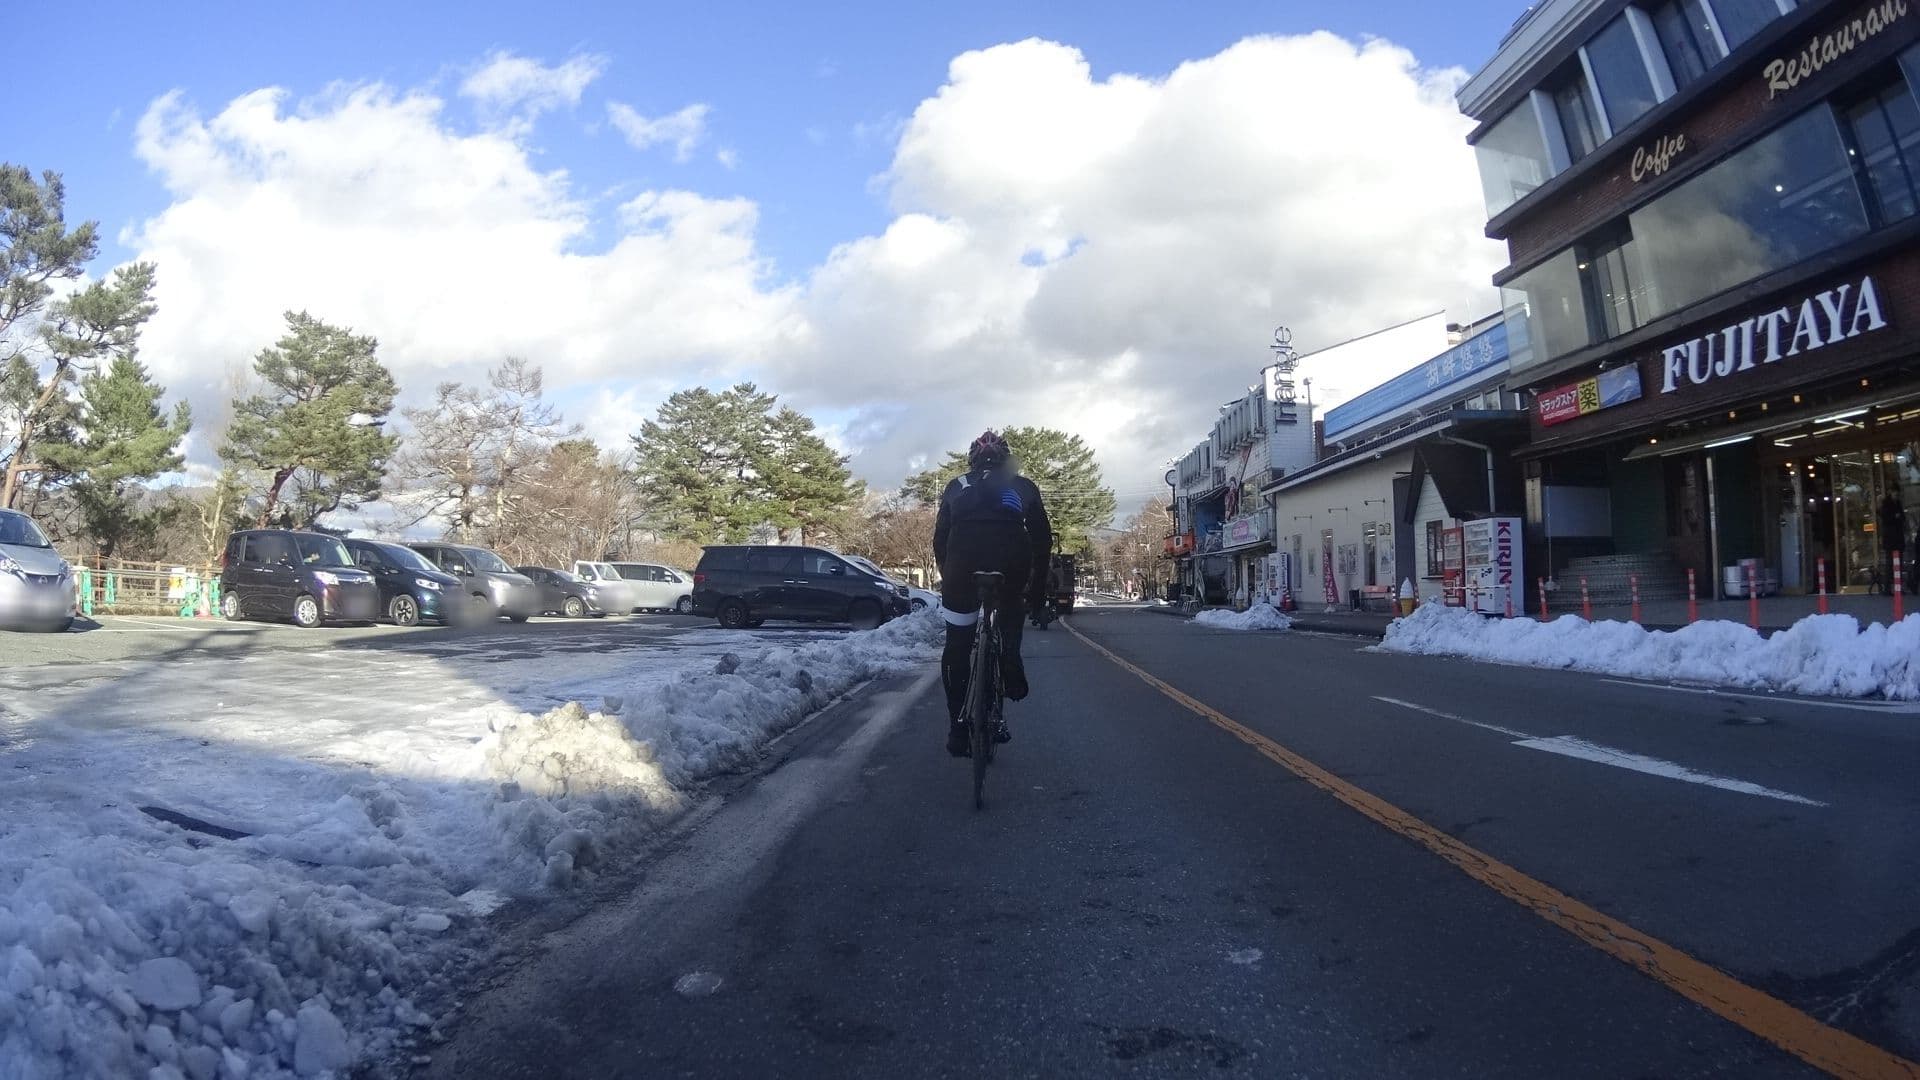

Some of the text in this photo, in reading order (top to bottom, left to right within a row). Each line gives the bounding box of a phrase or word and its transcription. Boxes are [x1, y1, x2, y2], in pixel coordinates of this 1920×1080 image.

[1630, 132, 1686, 183] Coffee
[1660, 275, 1888, 394] FUJITAYA
[1539, 390, 1577, 413] ドラッグストア
[1579, 381, 1598, 410] 薬
[1497, 521, 1512, 584] KIRIN
